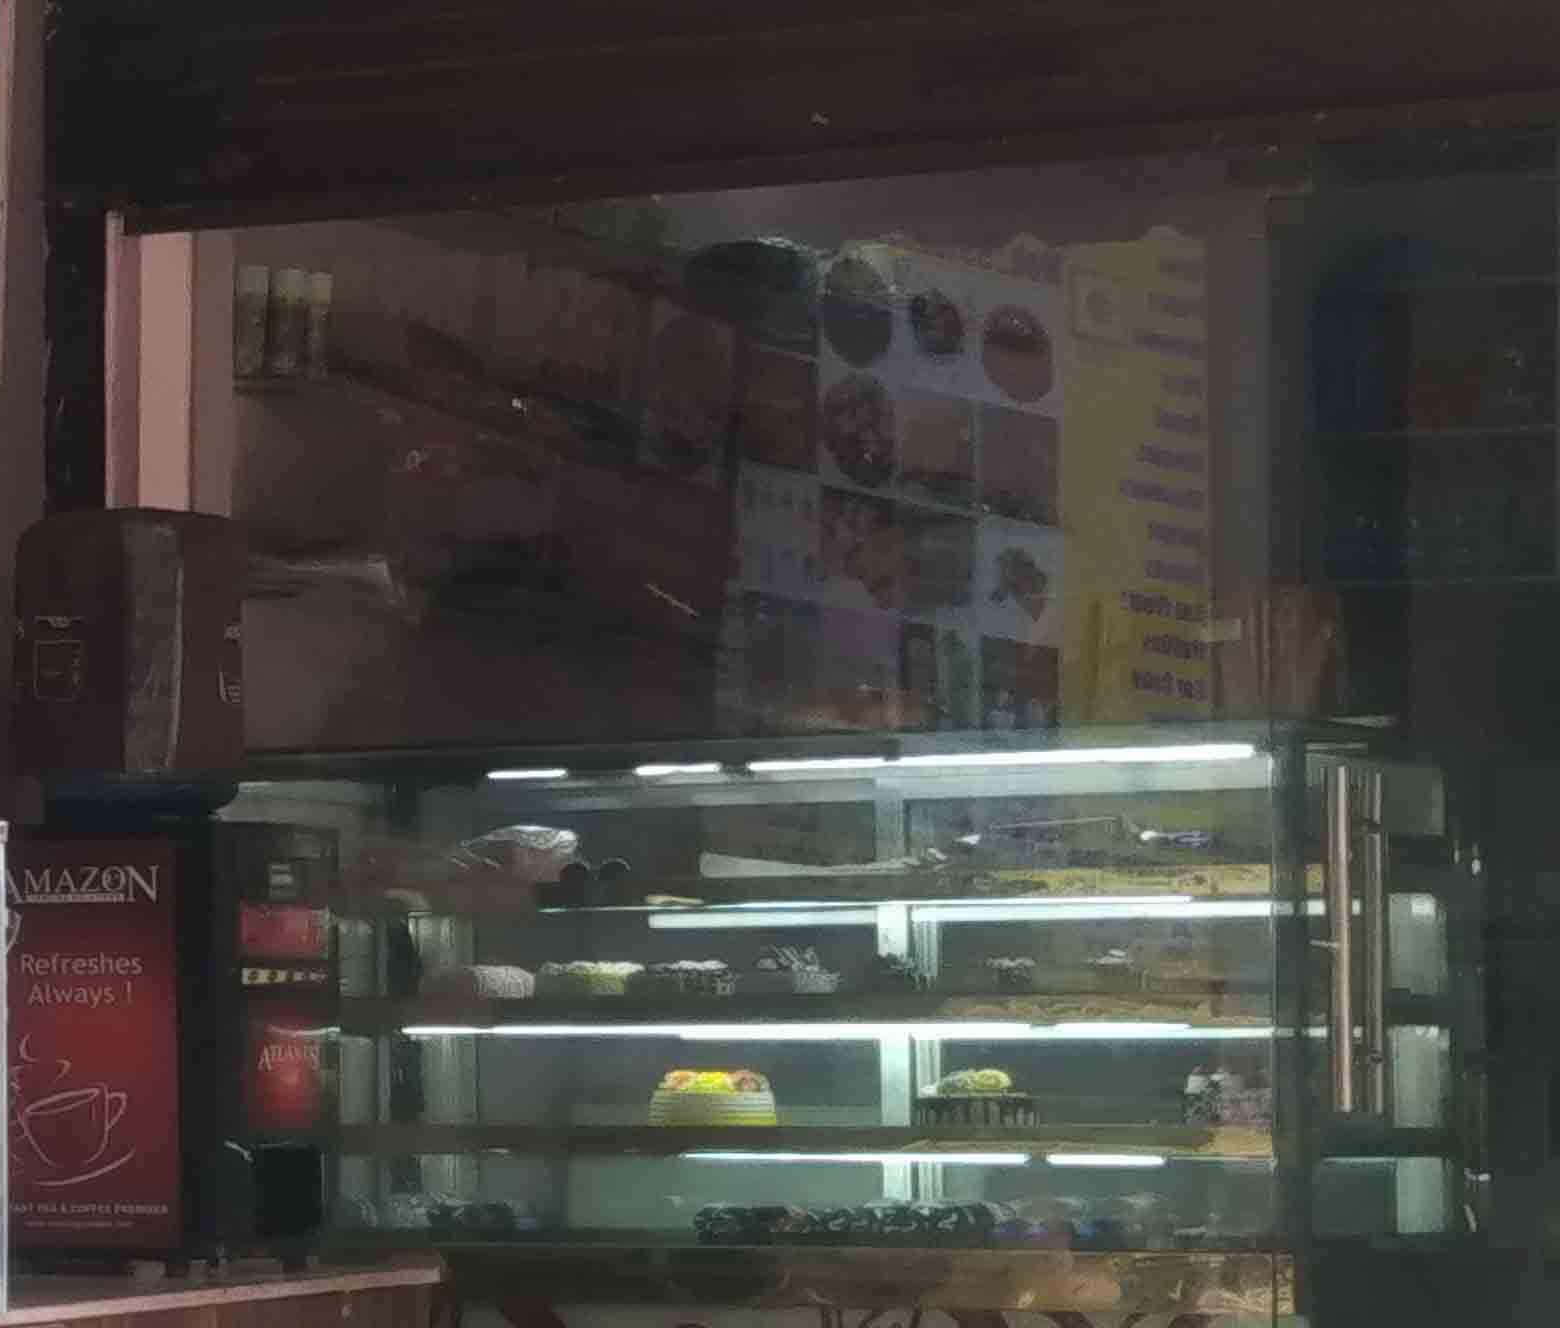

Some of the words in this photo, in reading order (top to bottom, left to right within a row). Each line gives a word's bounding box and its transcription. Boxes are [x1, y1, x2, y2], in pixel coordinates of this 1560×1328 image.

[5, 864, 160, 904] AMAZON
[21, 952, 144, 975] Refreshes
[28, 981, 116, 1009] Always
